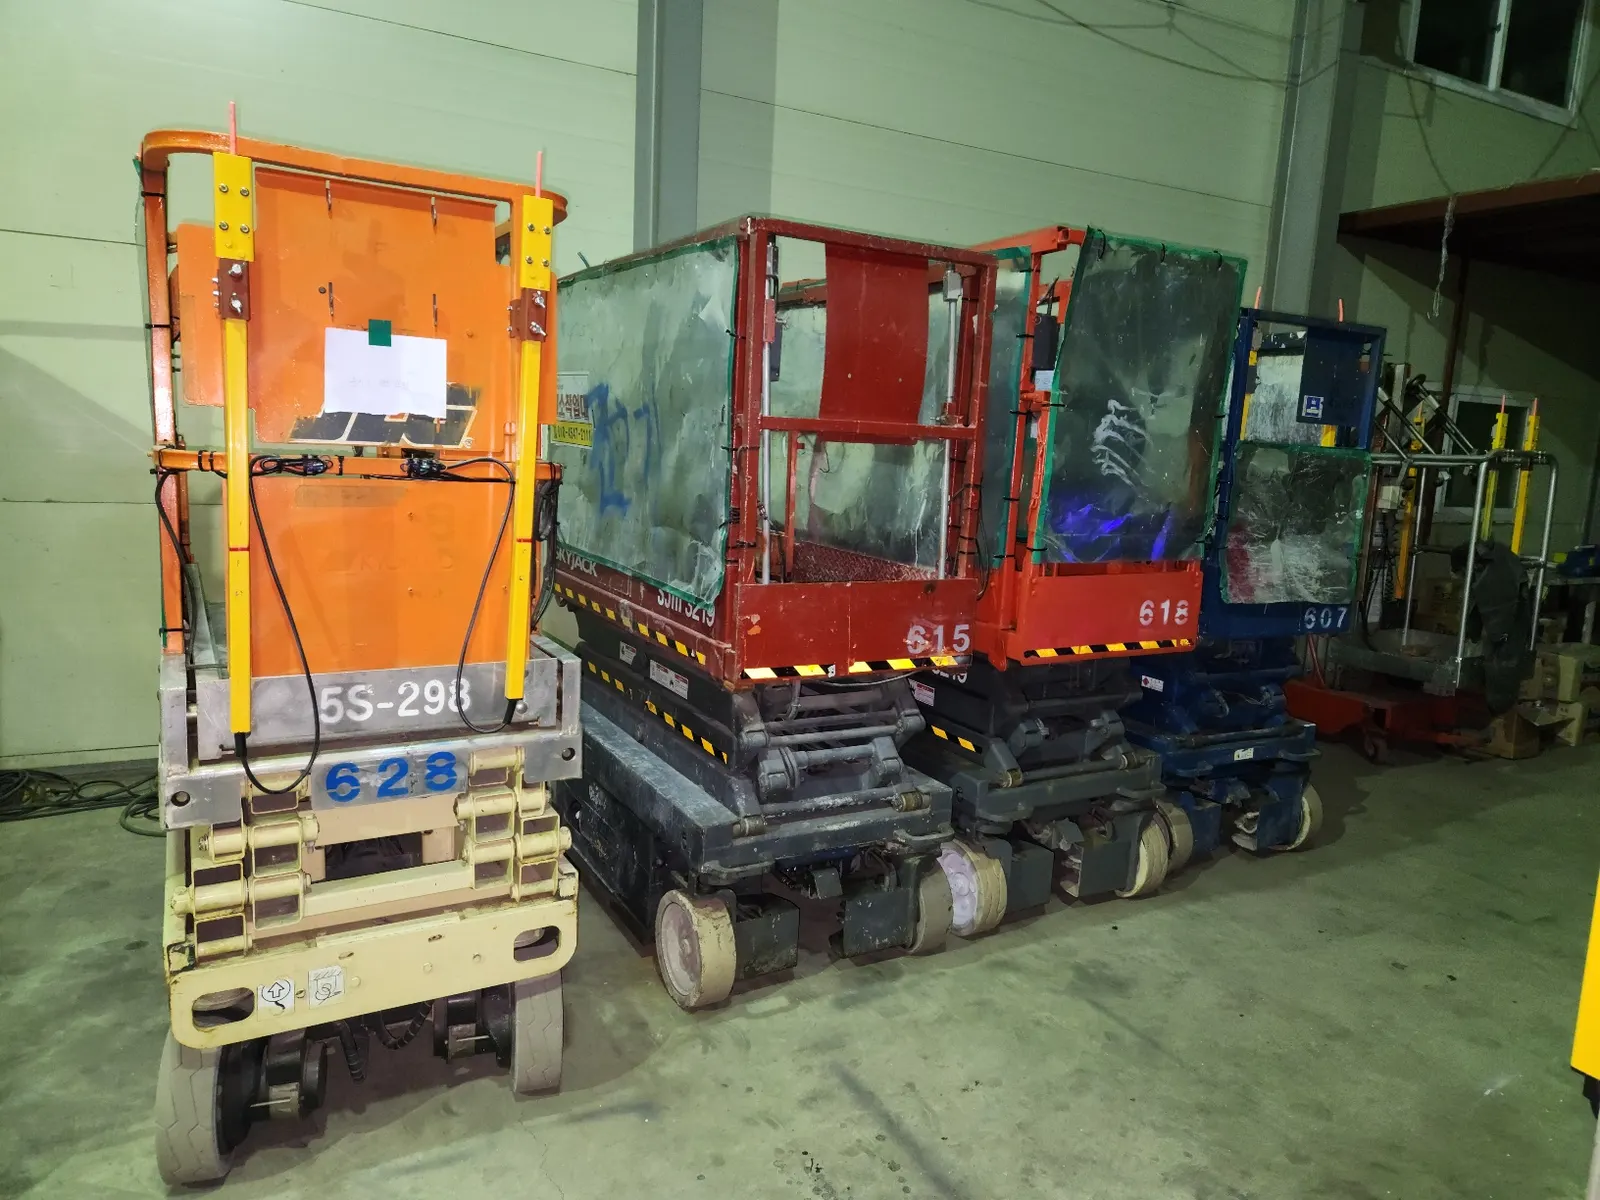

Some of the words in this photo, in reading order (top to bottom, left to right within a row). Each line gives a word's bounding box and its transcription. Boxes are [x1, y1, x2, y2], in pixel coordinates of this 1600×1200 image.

[1139, 600, 1189, 627] 618
[1303, 606, 1348, 629] 607
[906, 624, 971, 654] 615
[318, 677, 471, 724] 5S-298
[325, 751, 458, 803] 628
